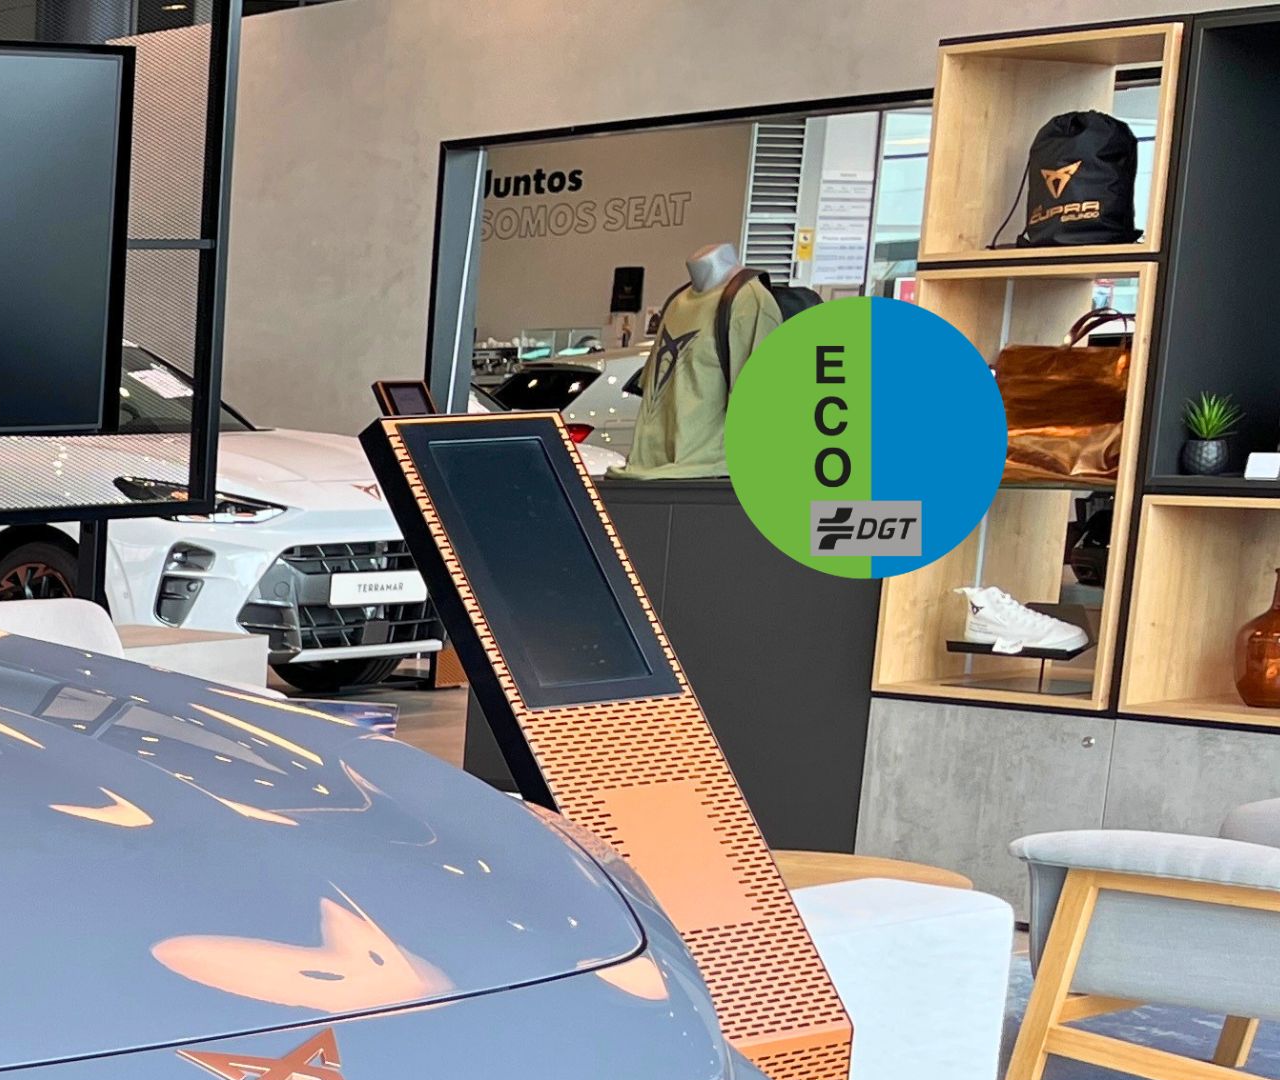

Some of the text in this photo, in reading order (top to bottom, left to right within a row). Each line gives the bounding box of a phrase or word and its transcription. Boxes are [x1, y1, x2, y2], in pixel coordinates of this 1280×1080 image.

[481, 191, 692, 241] SOMOS SEAT
[357, 583, 404, 593] TERRAMAR
